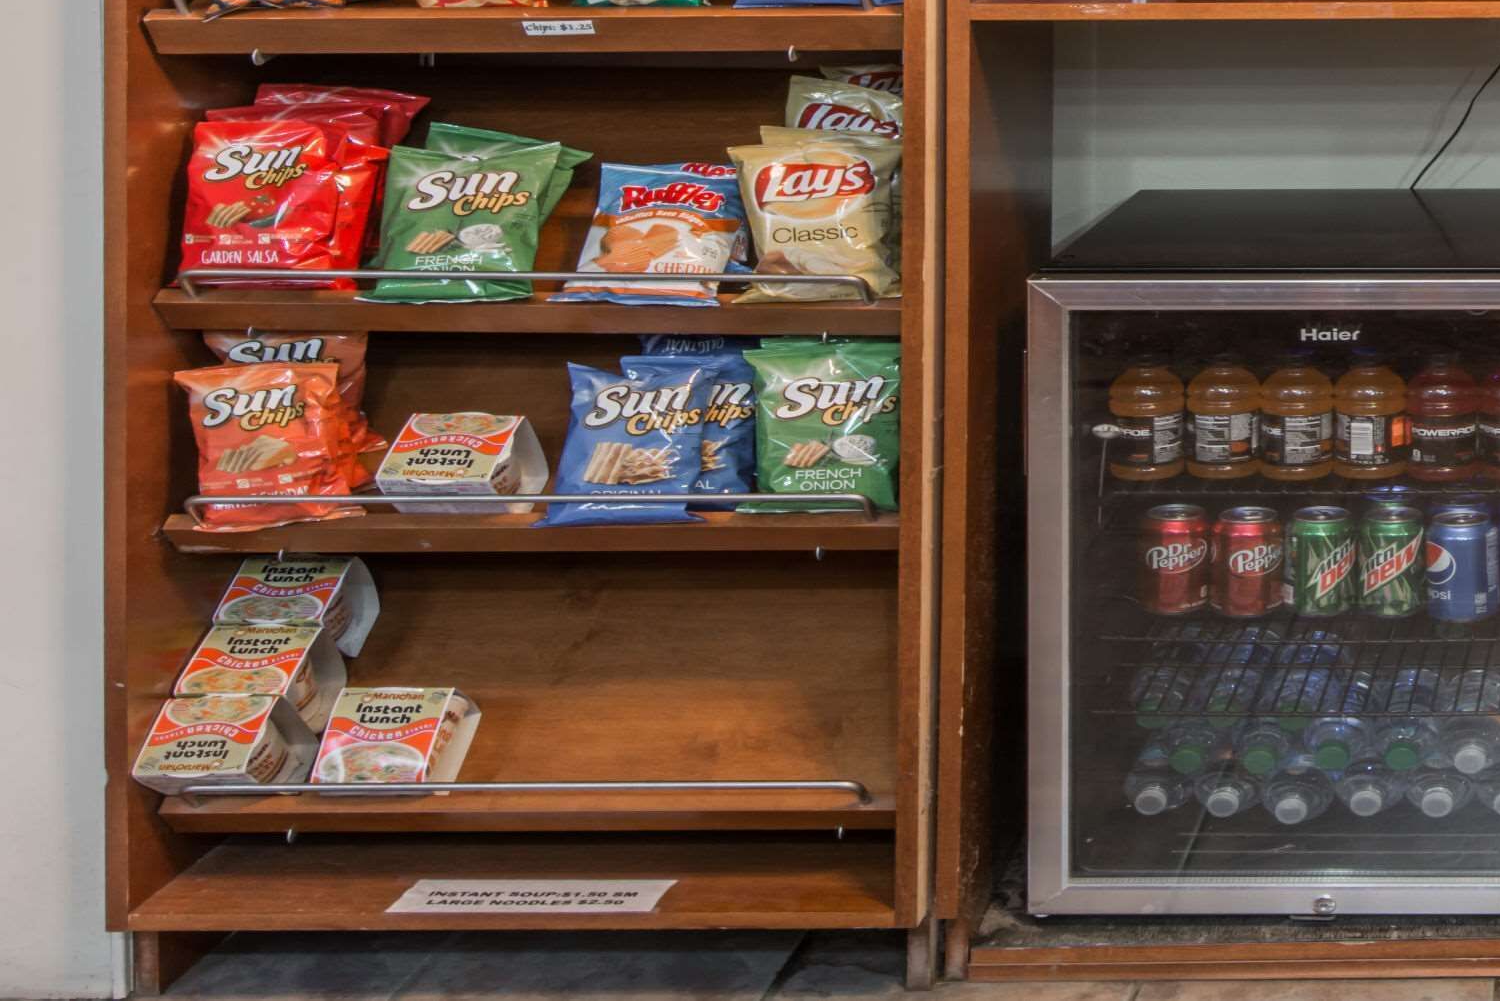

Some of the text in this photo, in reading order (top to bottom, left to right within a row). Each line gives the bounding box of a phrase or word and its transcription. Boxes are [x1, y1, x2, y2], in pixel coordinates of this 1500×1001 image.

[204, 144, 305, 182] Sun
[245, 161, 307, 190] Chips
[756, 161, 868, 205] Lay's
[407, 170, 522, 212] Sun
[620, 182, 727, 213] Ruffles
[452, 189, 532, 217] Chips
[772, 224, 859, 245] Classic
[201, 249, 279, 265] GARDEN SALSA
[415, 254, 483, 266] FRENCH
[1300, 327, 1362, 342] Haier
[228, 337, 324, 364] Sun
[775, 374, 886, 421] Sun
[202, 383, 298, 429] Sun
[584, 384, 692, 430] Sun
[822, 394, 898, 427] Chips
[240, 401, 305, 432] Chips
[625, 407, 703, 437] Chips
[419, 448, 473, 458] Lunch
[406, 457, 475, 469] Instant
[796, 468, 863, 481] FRENCH
[800, 479, 857, 492] ONION
[1149, 545, 1207, 570] Pepper
[1168, 542, 1193, 558] Dr
[1254, 544, 1276, 559] Dr
[261, 564, 327, 576] Instant
[263, 573, 316, 584] Lunch
[251, 582, 303, 597] Chicken
[245, 626, 298, 636] Maruchan
[227, 636, 293, 648] Instant
[228, 645, 280, 656] Lunch
[216, 654, 269, 670] Chicken
[371, 691, 426, 702] Maruchan
[355, 703, 424, 715] Instant
[359, 712, 412, 725] Lunch
[186, 723, 241, 738] Chicken
[350, 724, 403, 742] Chicken
[176, 739, 228, 750] Lunch
[163, 749, 230, 760] Instant
[429, 890, 505, 898] INSTANT
[612, 890, 640, 898] SM
[576, 898, 625, 906] $2.50
